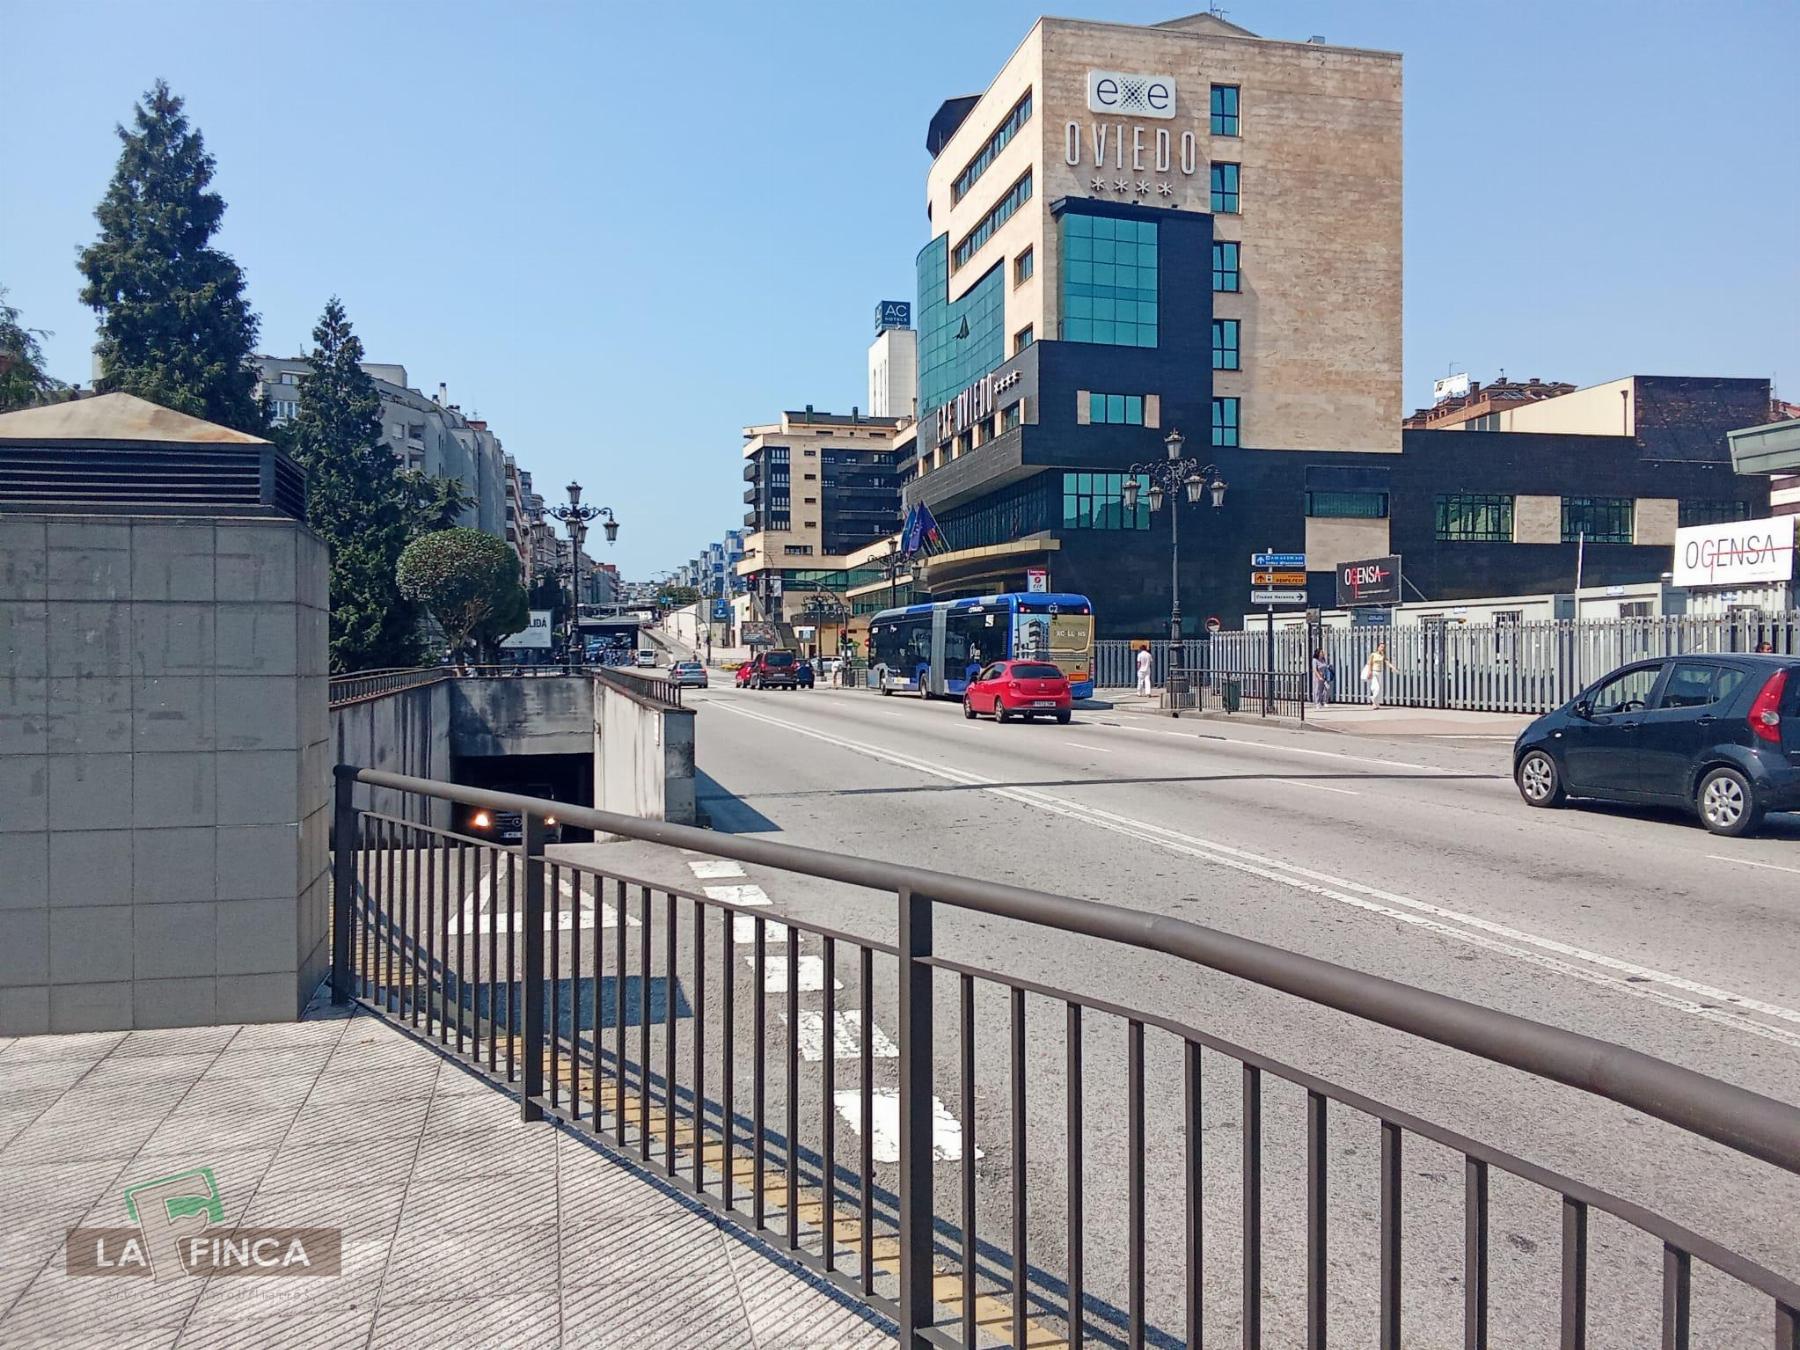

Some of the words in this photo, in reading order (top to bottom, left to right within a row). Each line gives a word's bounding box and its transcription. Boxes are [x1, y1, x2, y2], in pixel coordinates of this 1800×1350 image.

[1065, 121, 1196, 175] OVIEDO
[885, 304, 907, 317] AC
[937, 400, 953, 443] EXE
[957, 373, 993, 431] OVIEDO
[1685, 534, 1776, 570] OGENSA
[1344, 565, 1382, 586] OGENSA
